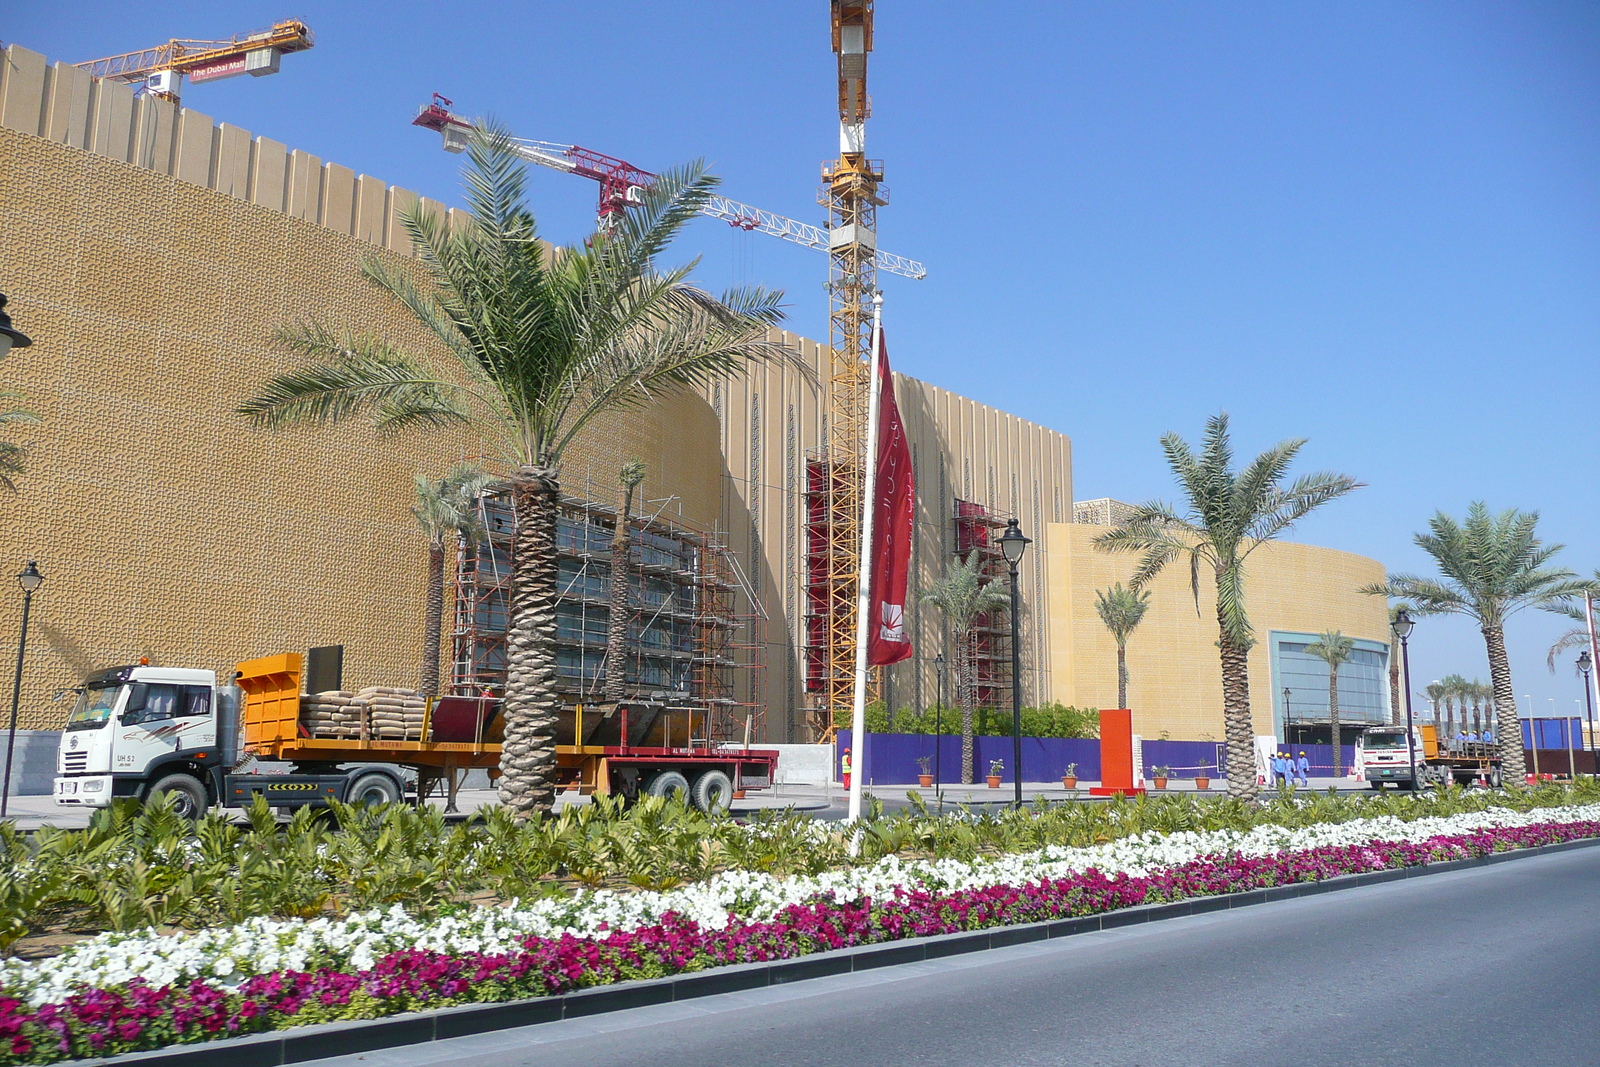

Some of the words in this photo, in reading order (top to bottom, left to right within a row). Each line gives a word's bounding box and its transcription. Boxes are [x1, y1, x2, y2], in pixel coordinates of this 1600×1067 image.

[193, 69, 206, 77] The
[207, 63, 228, 74] Dubai
[229, 59, 245, 70] Mall
